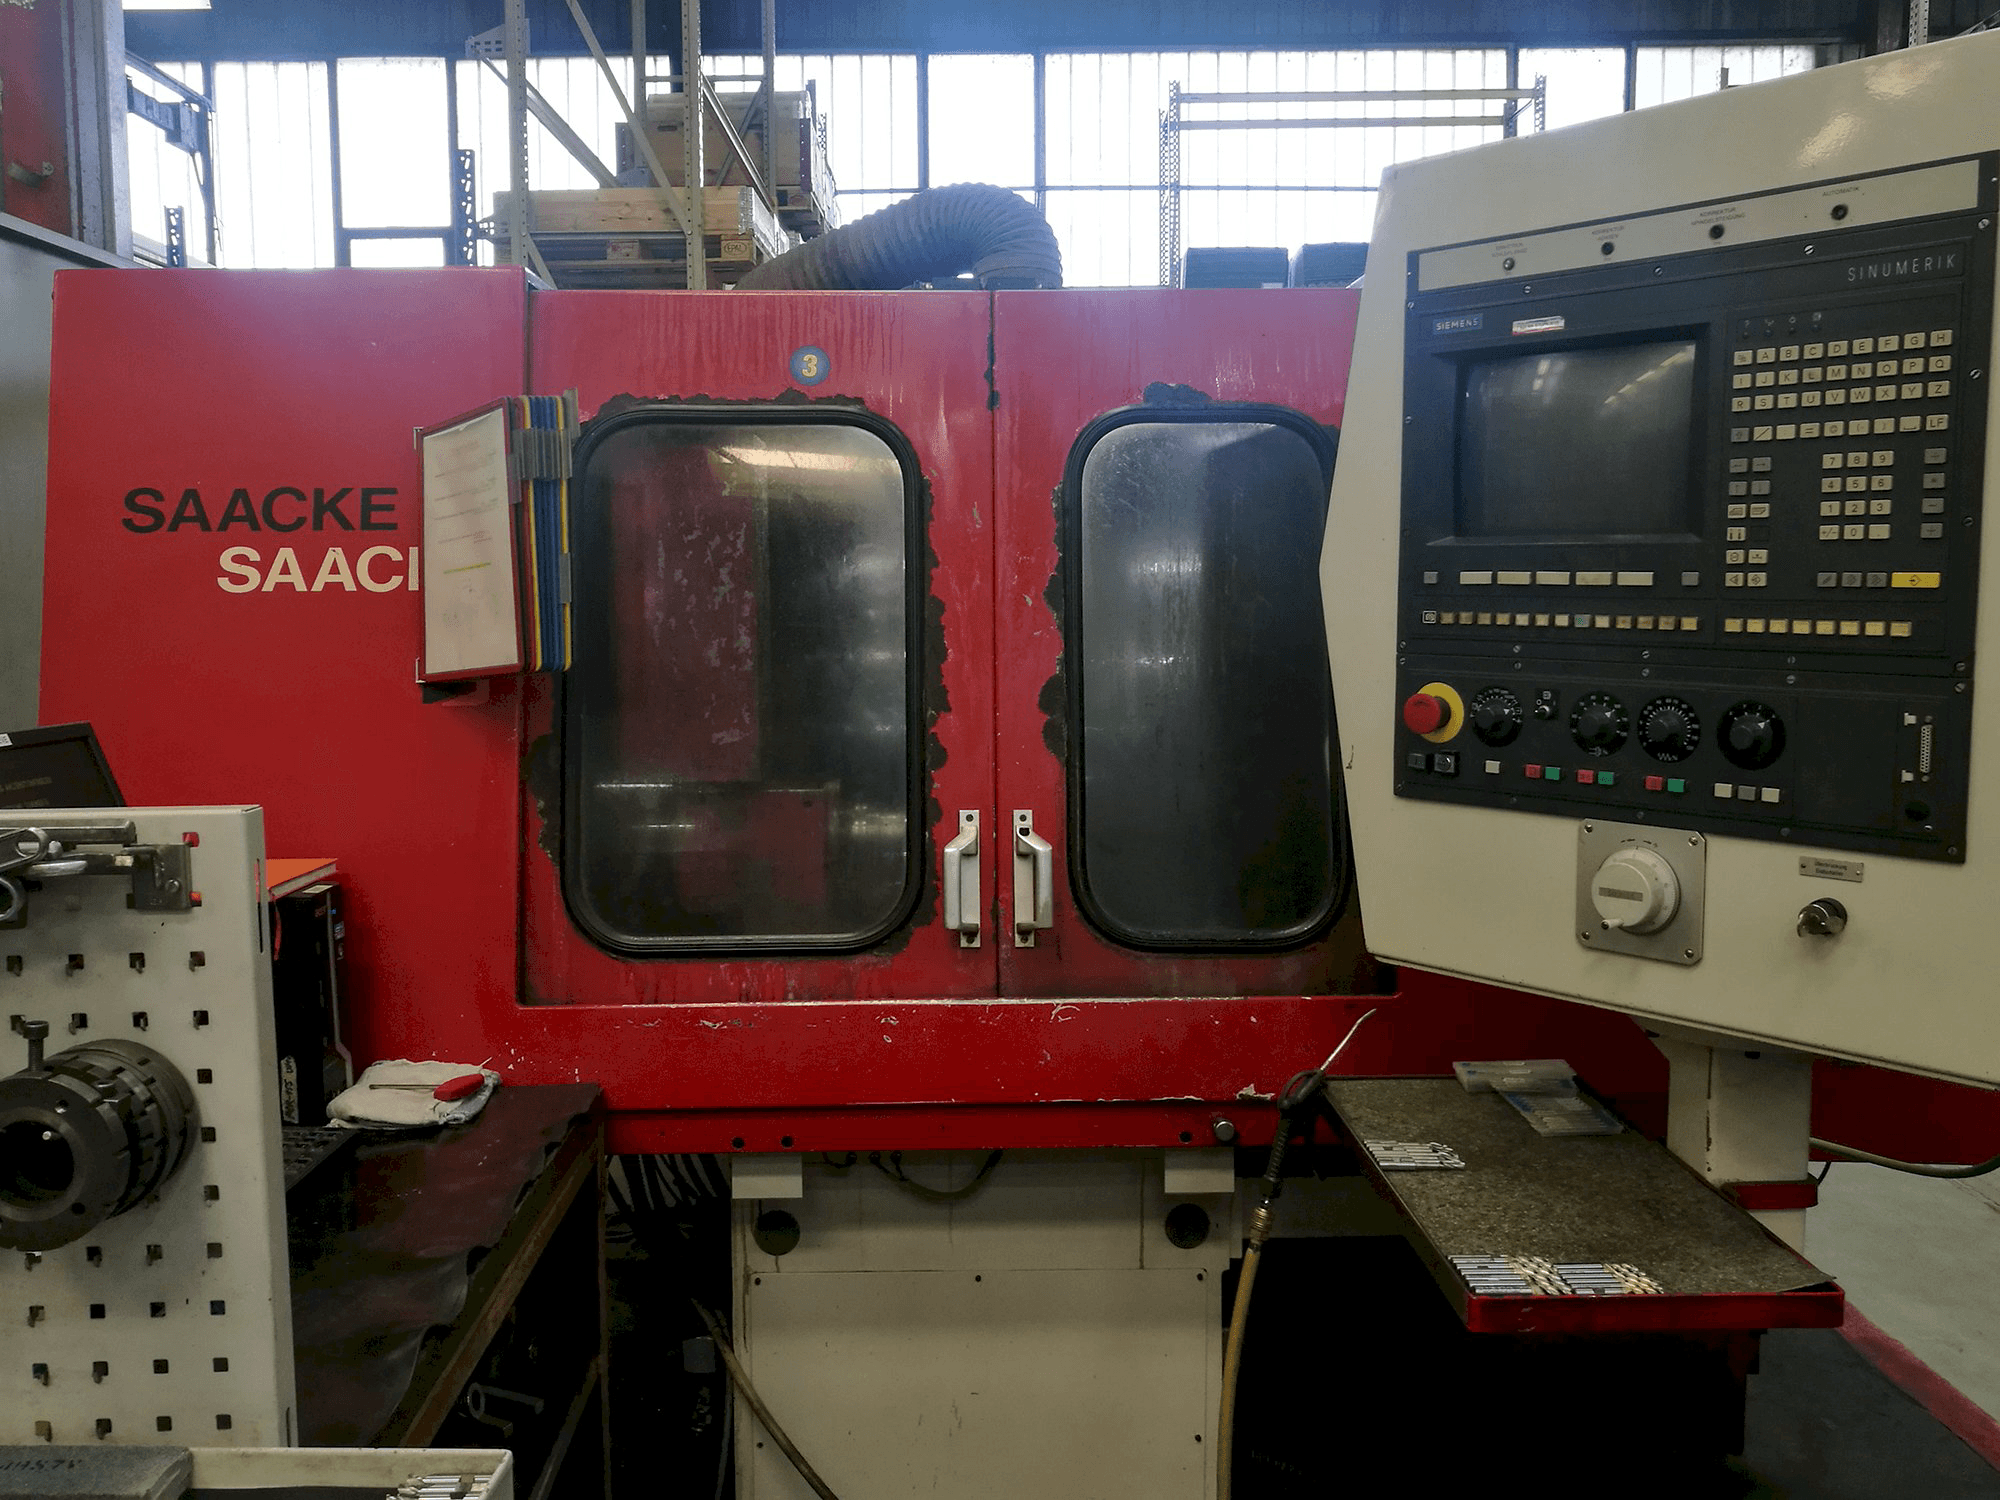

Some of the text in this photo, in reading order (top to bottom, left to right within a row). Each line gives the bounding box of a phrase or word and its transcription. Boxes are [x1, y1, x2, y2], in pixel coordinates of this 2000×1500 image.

[1822, 186, 1860, 197] AUTOMATIK
[1847, 254, 1956, 282] SINUMERIK
[1435, 318, 1478, 331] SIEMENS
[802, 354, 818, 377] 3
[121, 486, 398, 534] SAACKE
[217, 545, 420, 594] SAAC
